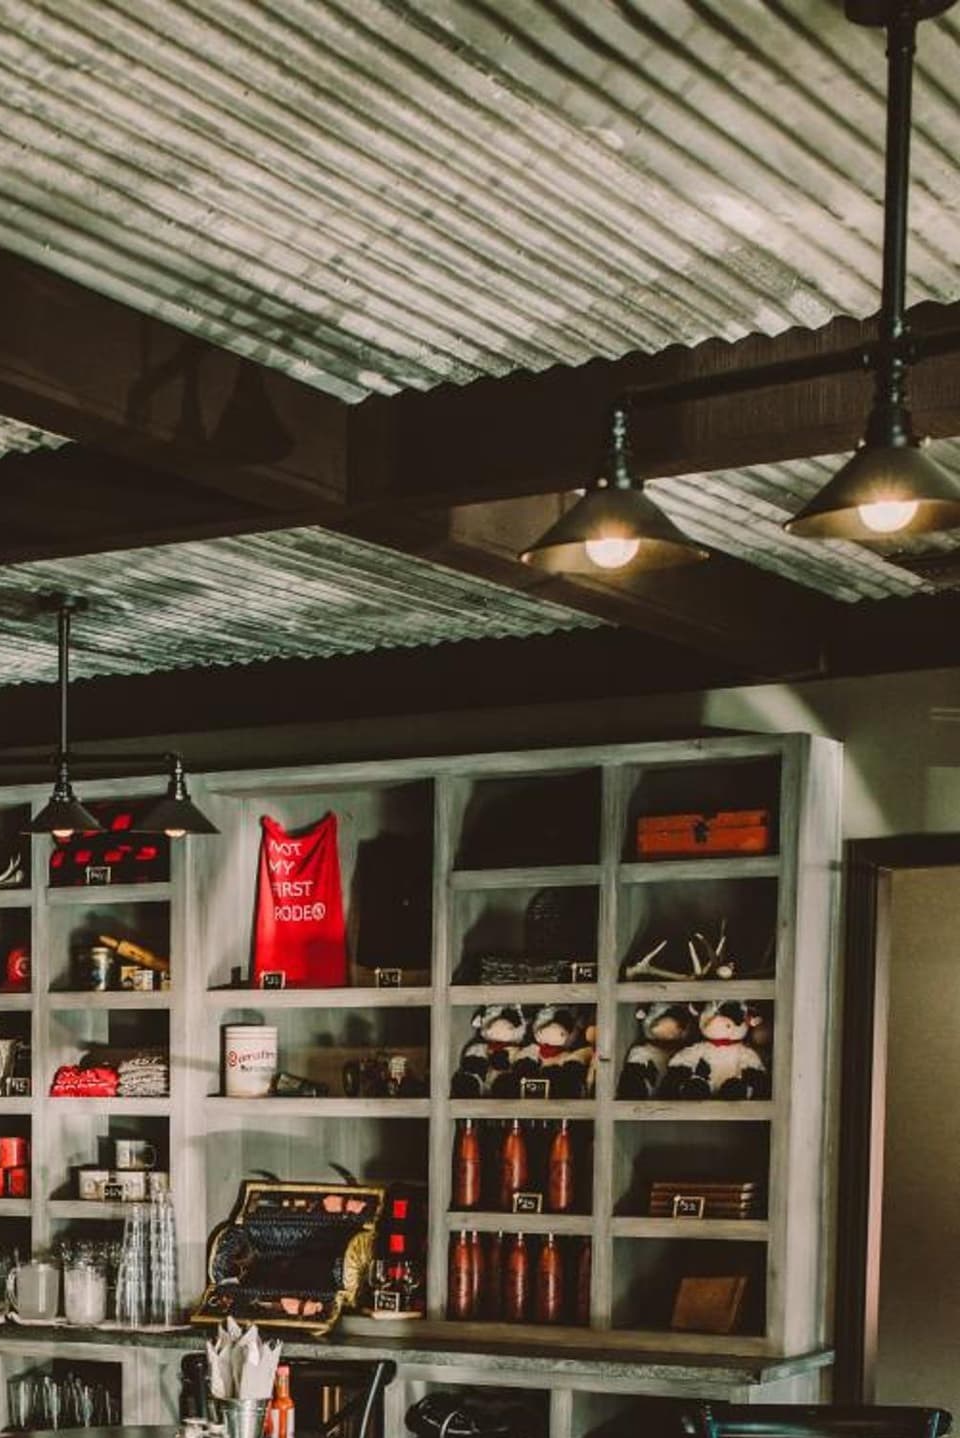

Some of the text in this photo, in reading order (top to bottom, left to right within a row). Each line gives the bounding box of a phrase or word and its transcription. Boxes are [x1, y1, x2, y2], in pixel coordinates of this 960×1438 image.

[269, 840, 302, 856] NOT
[269, 860, 295, 875] MY
[274, 902, 326, 921] RODEO
